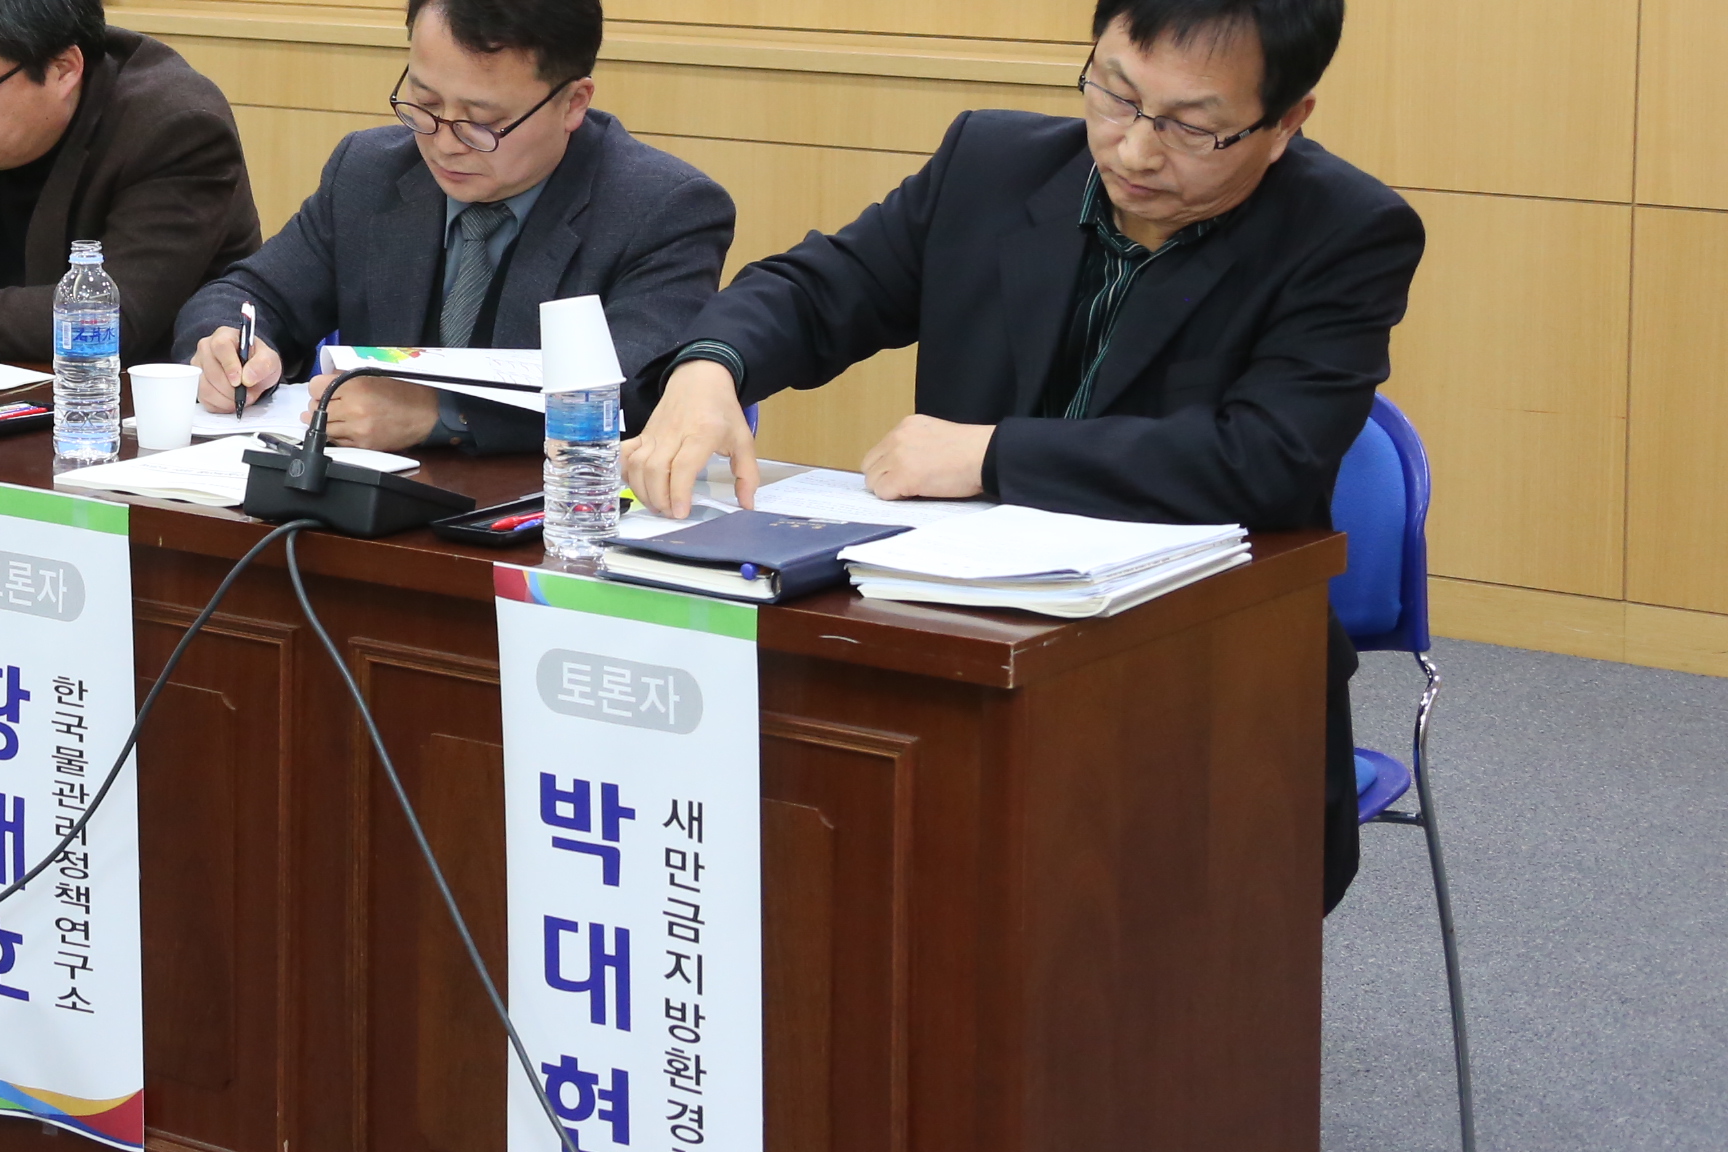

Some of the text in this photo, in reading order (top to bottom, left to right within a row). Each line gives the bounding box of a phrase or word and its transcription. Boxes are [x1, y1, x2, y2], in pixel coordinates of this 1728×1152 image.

[51, 675, 95, 1014] 한국물관리정책연구소
[557, 661, 680, 725] 토론자
[539, 771, 636, 1152] 박대현
[662, 798, 708, 1152] 새만금지방환경
